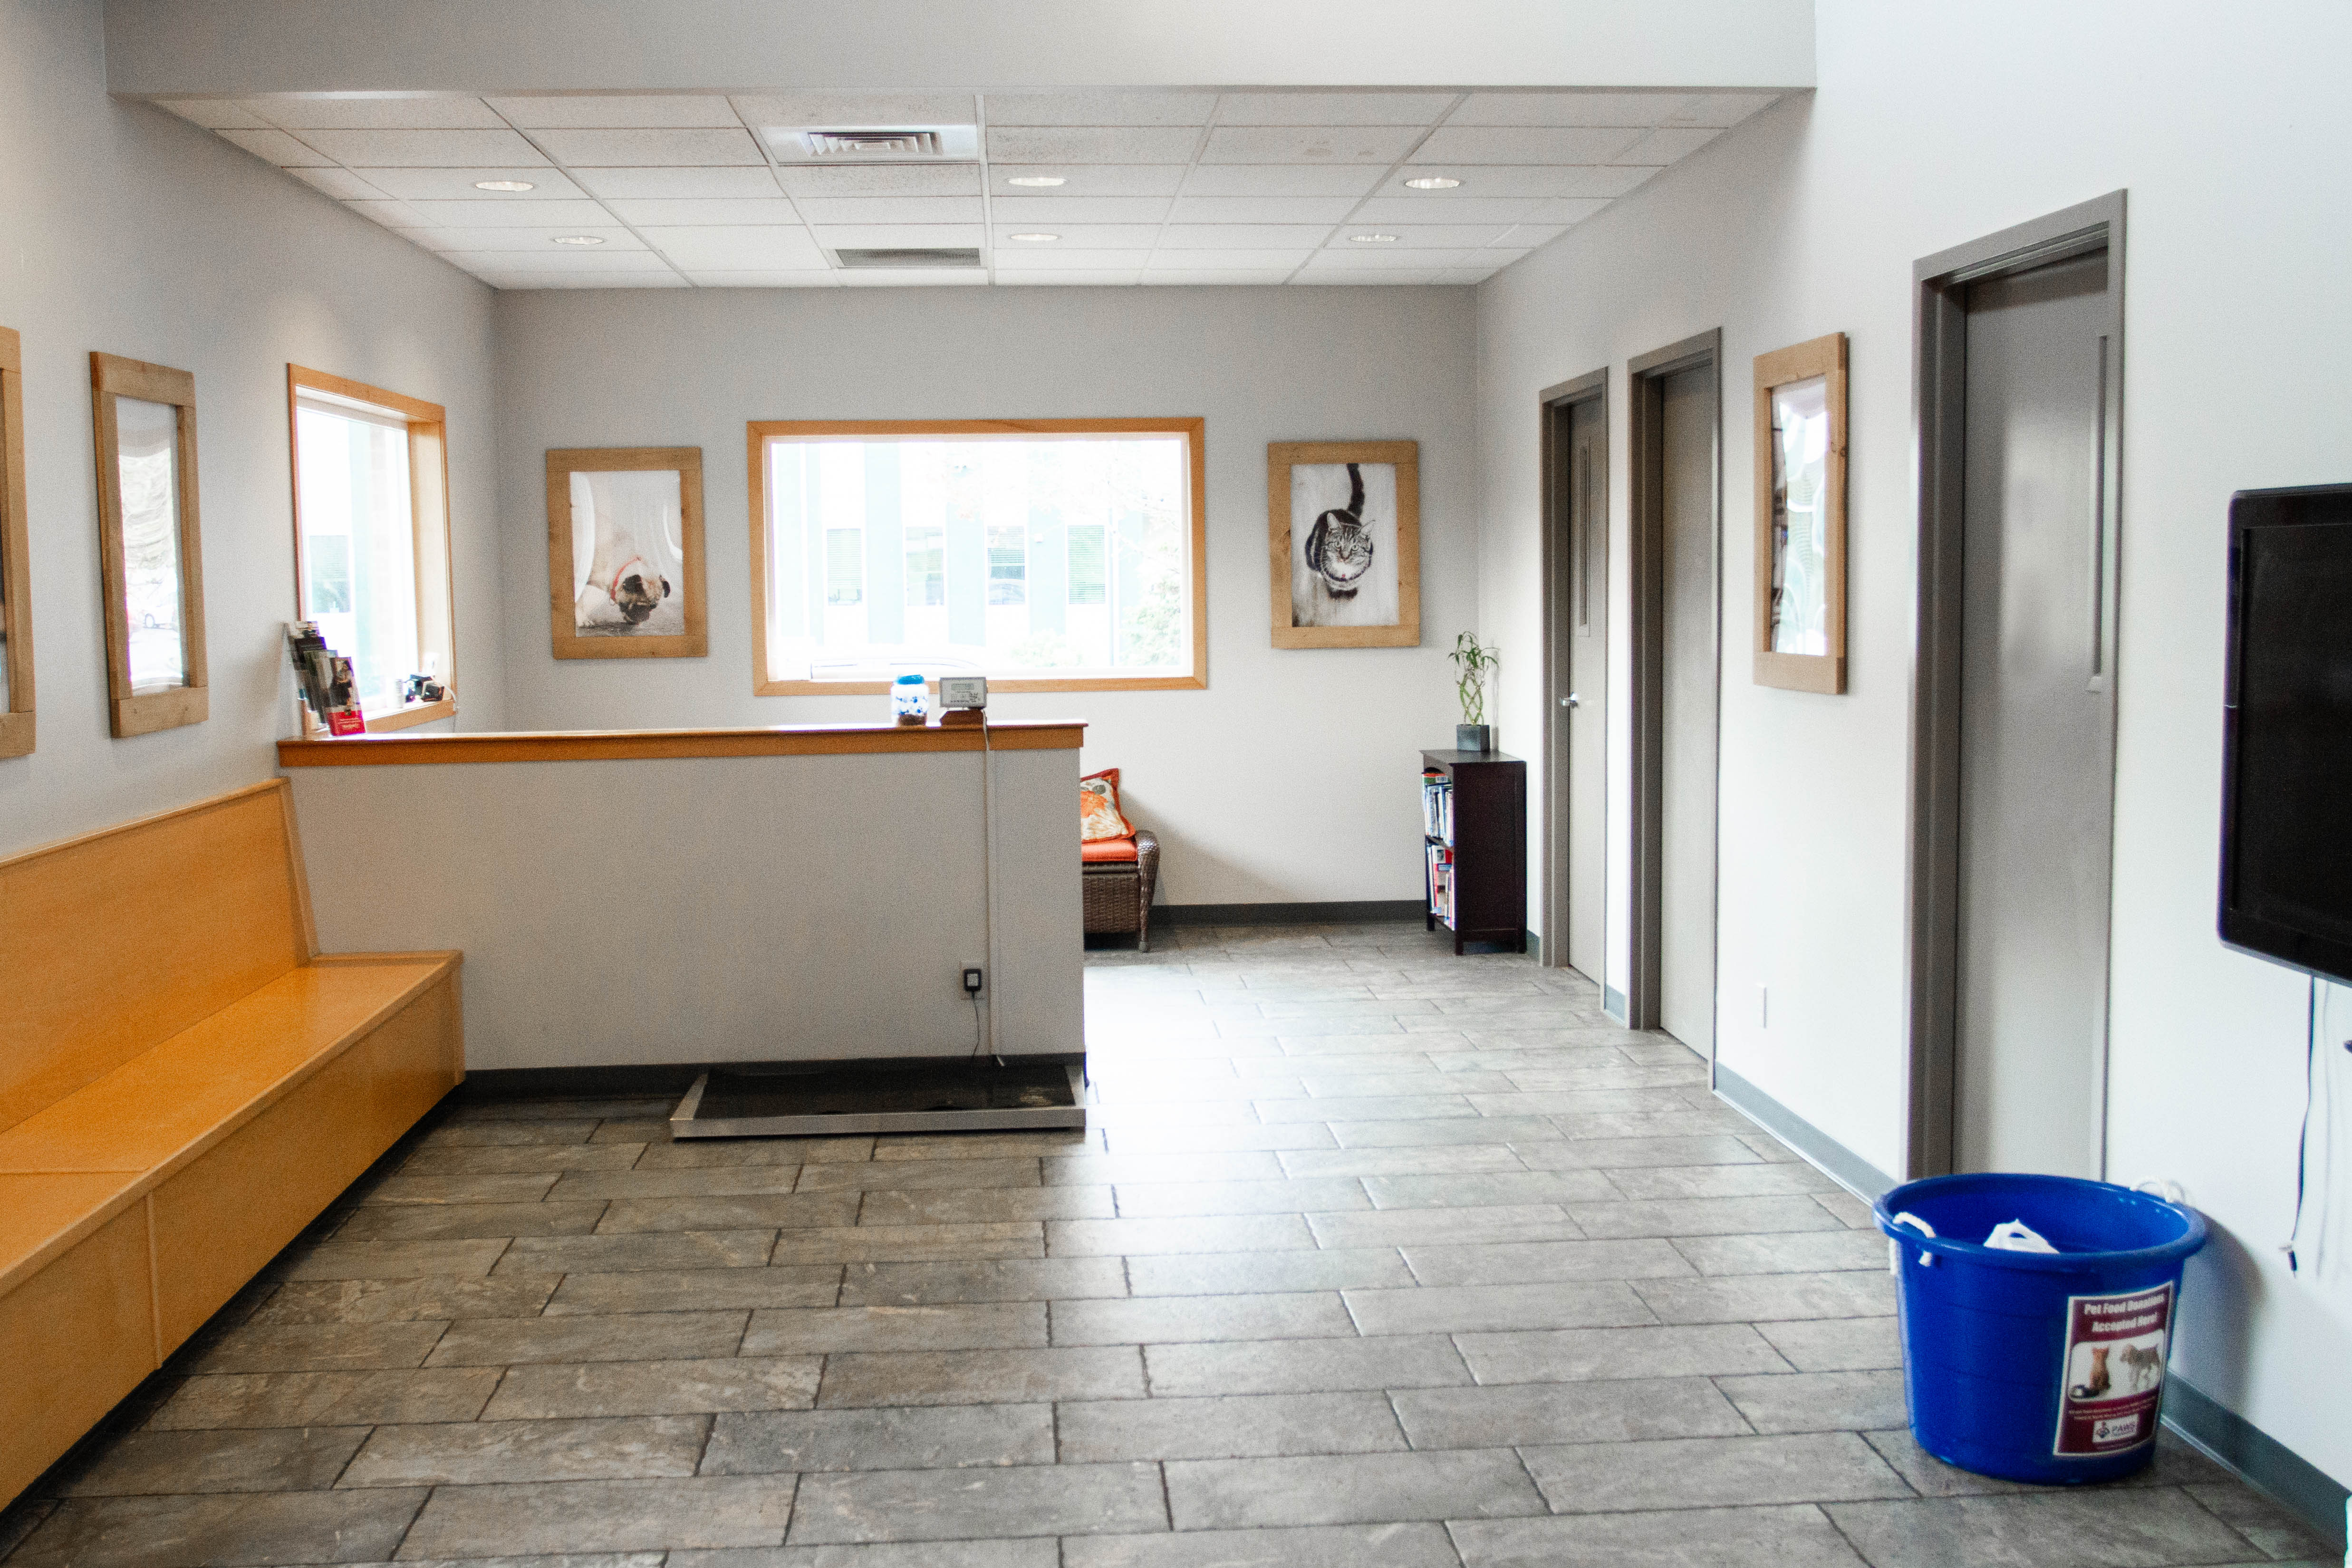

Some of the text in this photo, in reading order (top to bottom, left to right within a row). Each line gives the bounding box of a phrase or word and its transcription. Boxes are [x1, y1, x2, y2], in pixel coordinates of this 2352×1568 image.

[2085, 1294, 2165, 1315] Pet Food Donations
[2092, 1318, 2136, 1332] Accepted
